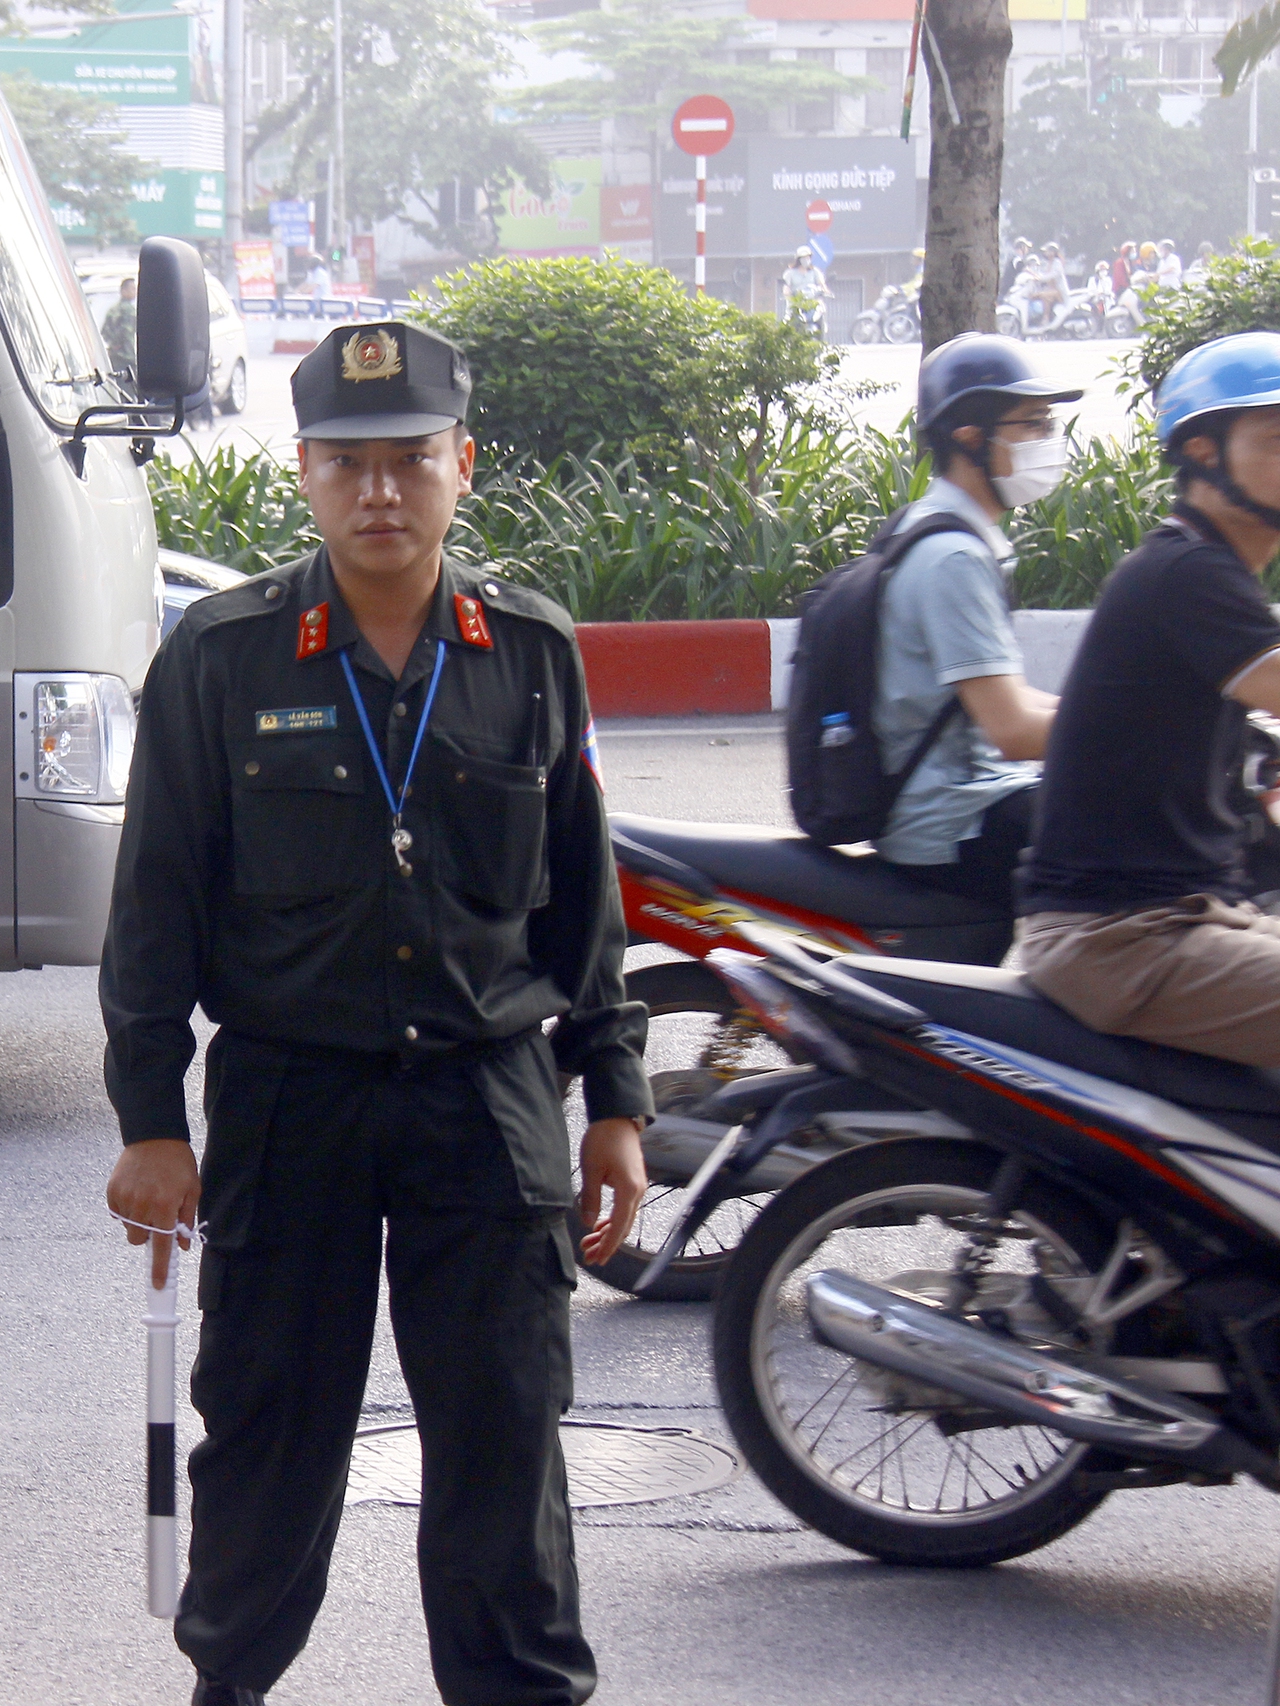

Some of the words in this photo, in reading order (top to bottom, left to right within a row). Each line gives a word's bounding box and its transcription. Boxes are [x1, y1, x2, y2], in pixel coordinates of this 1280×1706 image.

[772, 166, 803, 191] KÍNH
[804, 171, 839, 195] GỌNG
[841, 165, 867, 189] ĐỨC
[867, 164, 896, 192] TIỆP
